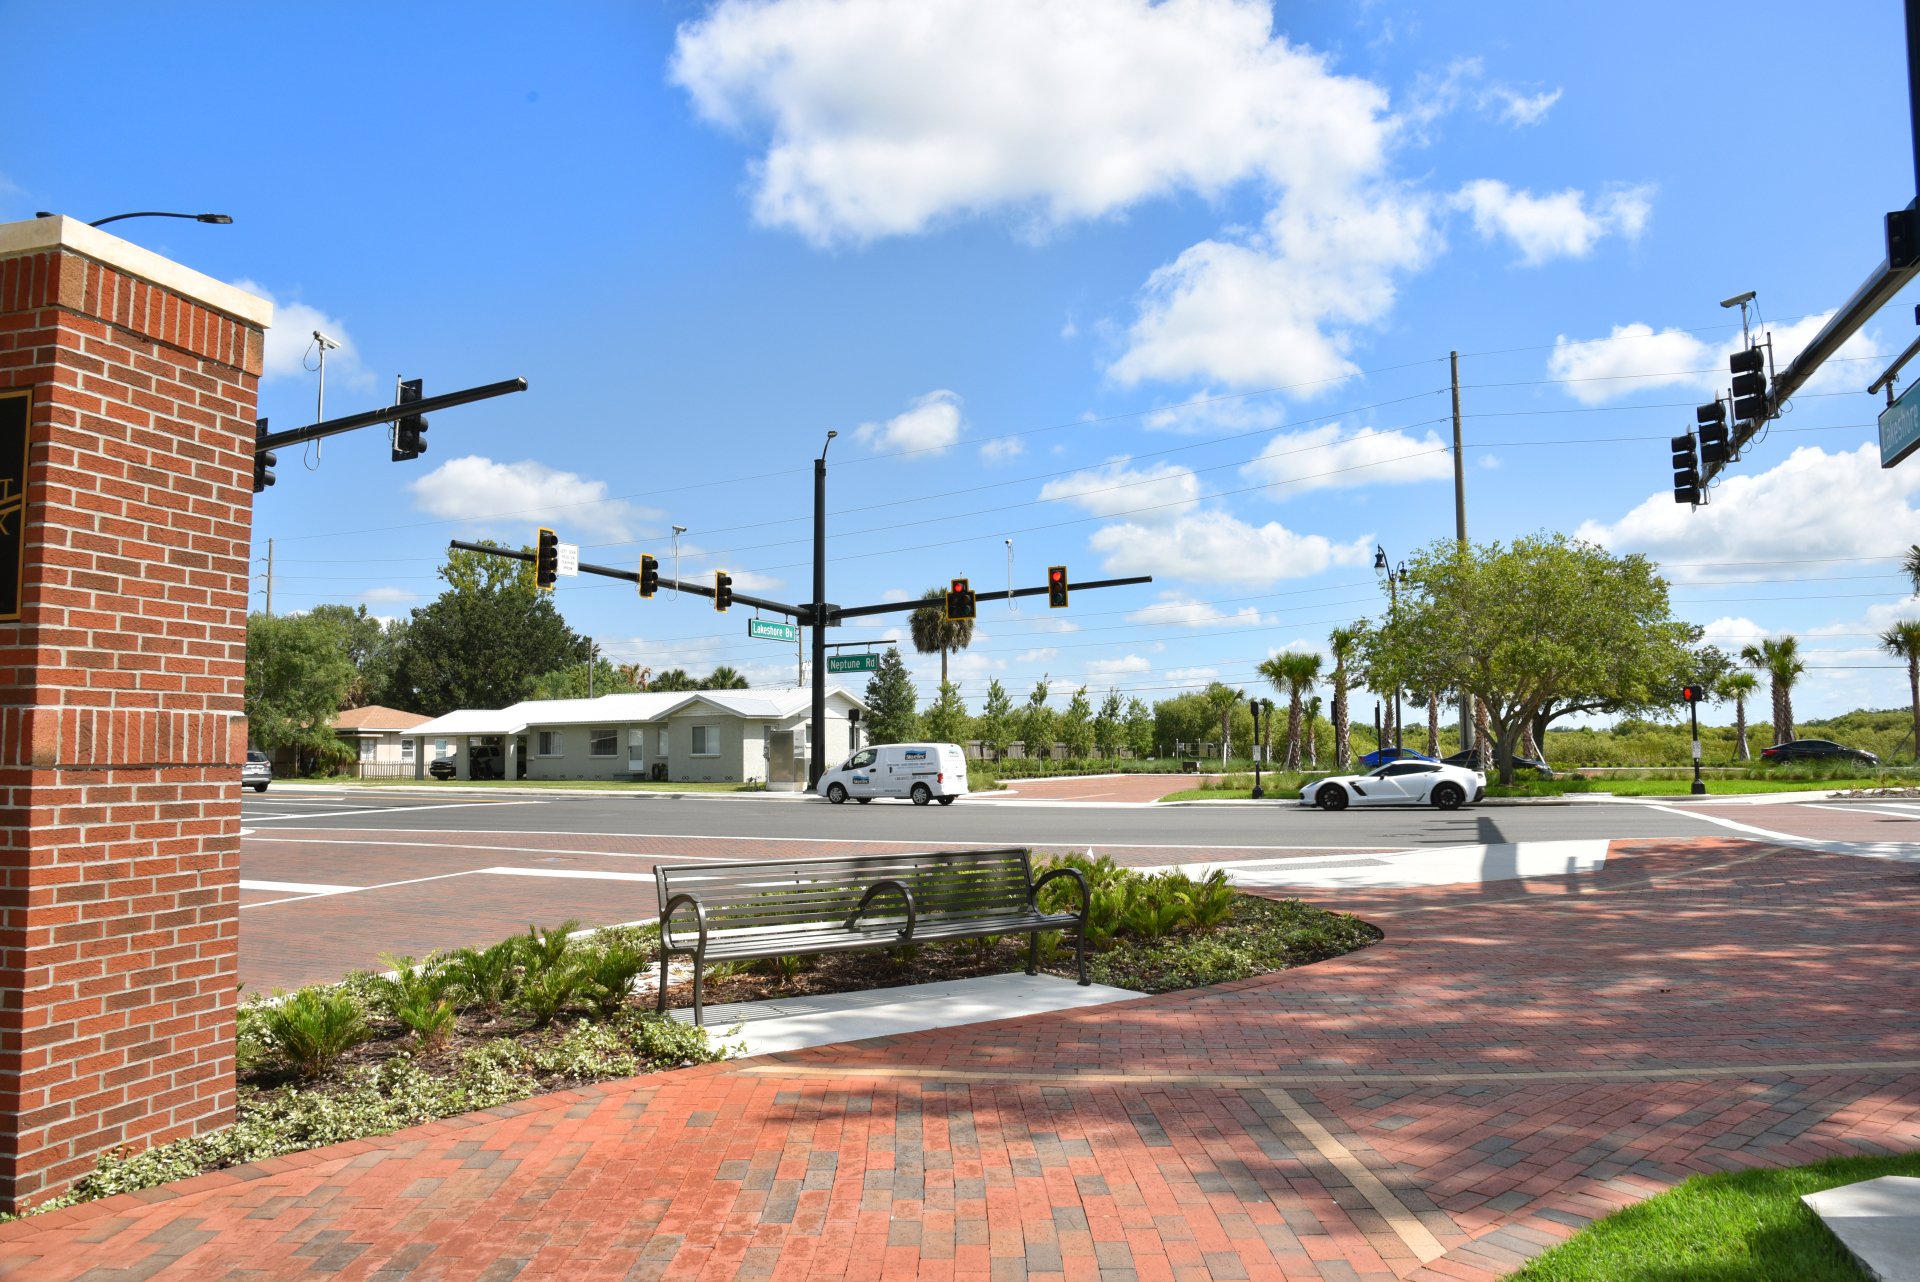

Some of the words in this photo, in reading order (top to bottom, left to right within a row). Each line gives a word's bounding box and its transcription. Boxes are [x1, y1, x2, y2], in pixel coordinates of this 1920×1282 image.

[1883, 404, 1918, 451] Lakeshore
[753, 623, 782, 637] Lakeshore
[830, 659, 860, 671] Neptune
[866, 657, 875, 668] Rd
